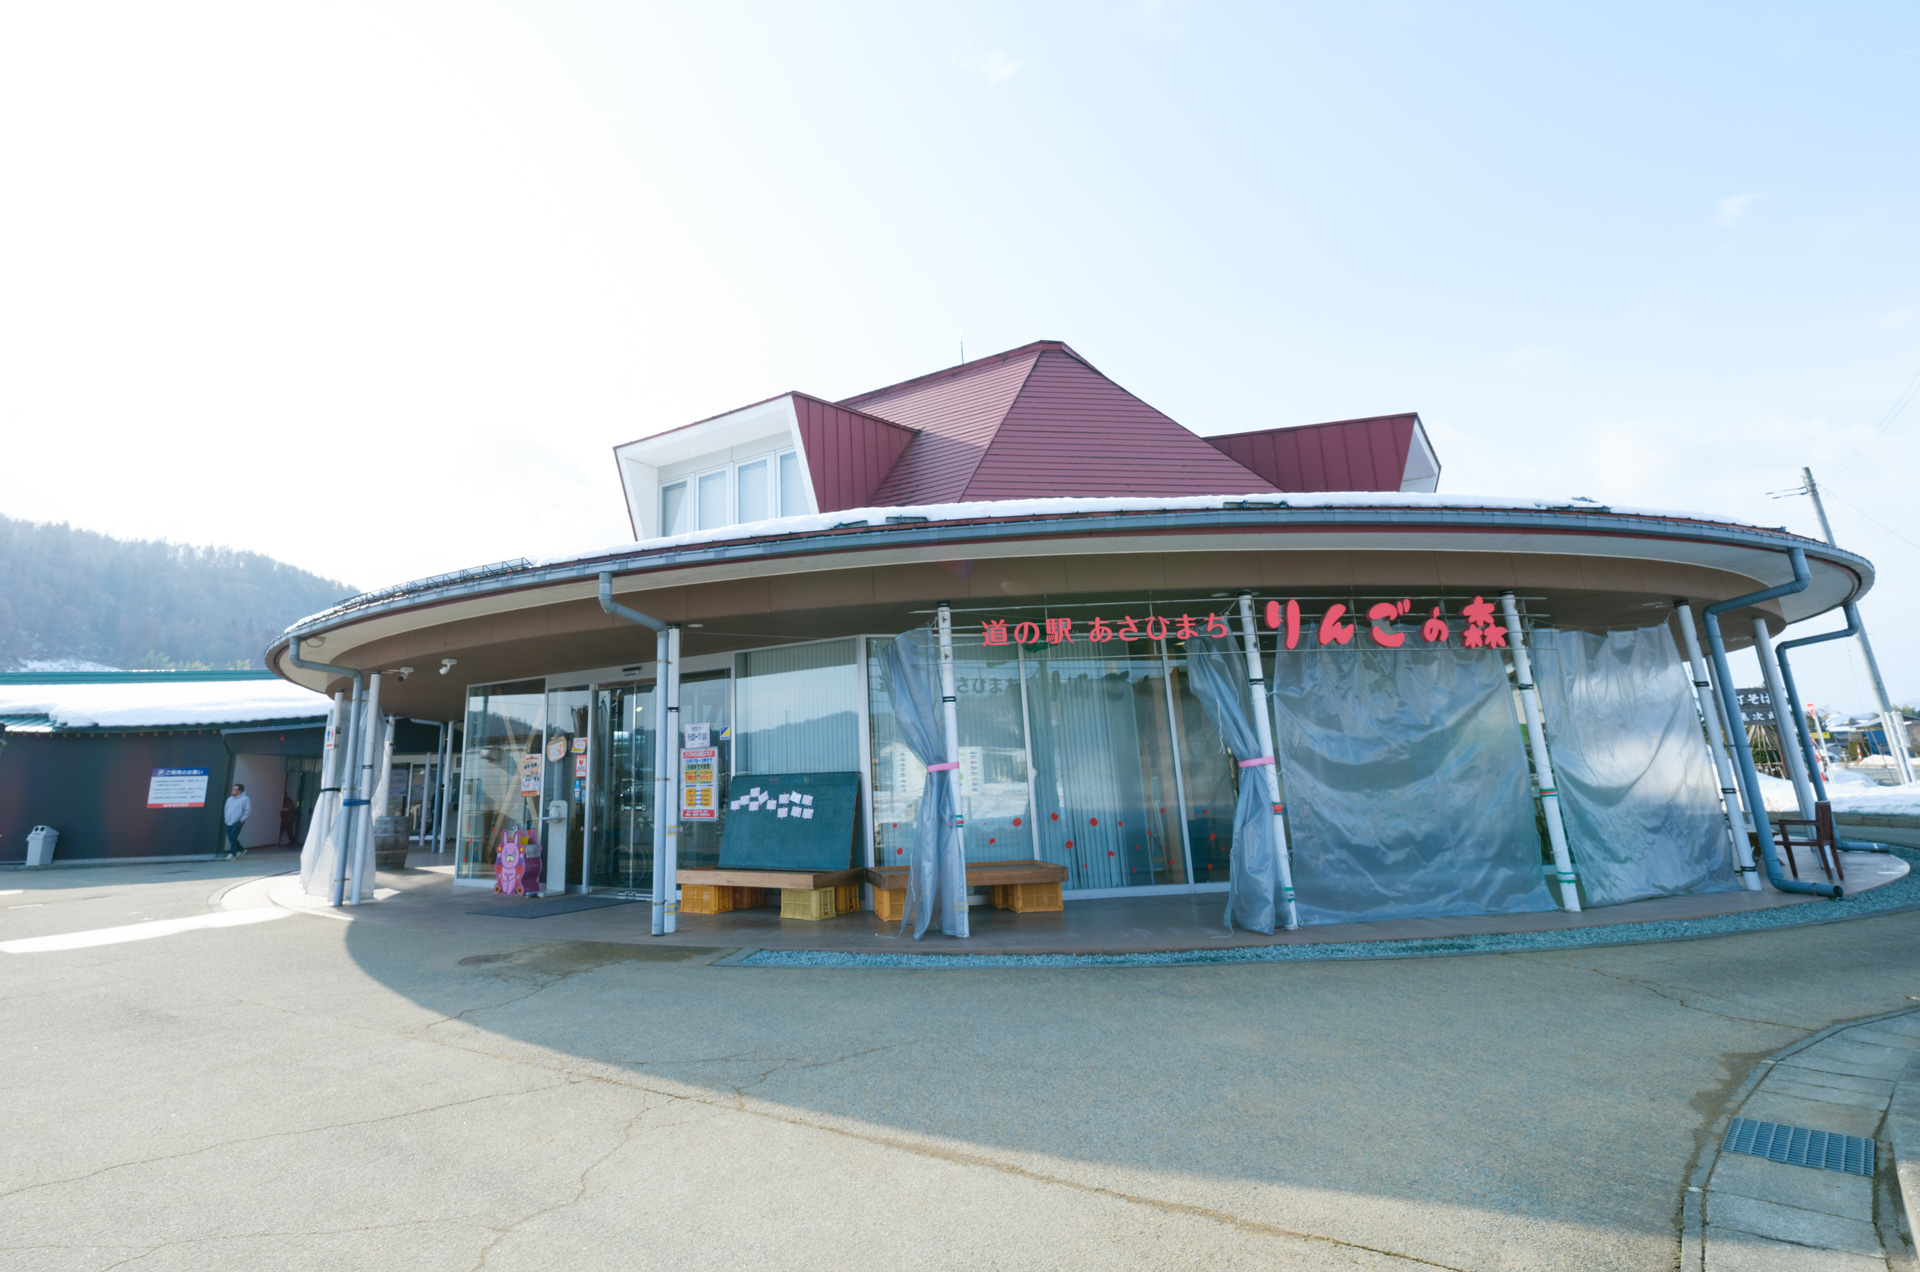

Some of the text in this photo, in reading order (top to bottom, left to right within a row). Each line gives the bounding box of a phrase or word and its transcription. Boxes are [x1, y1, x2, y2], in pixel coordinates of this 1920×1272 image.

[981, 612, 1229, 647] 道の駅 あさひまち
[1264, 595, 1507, 650] りんごの森
